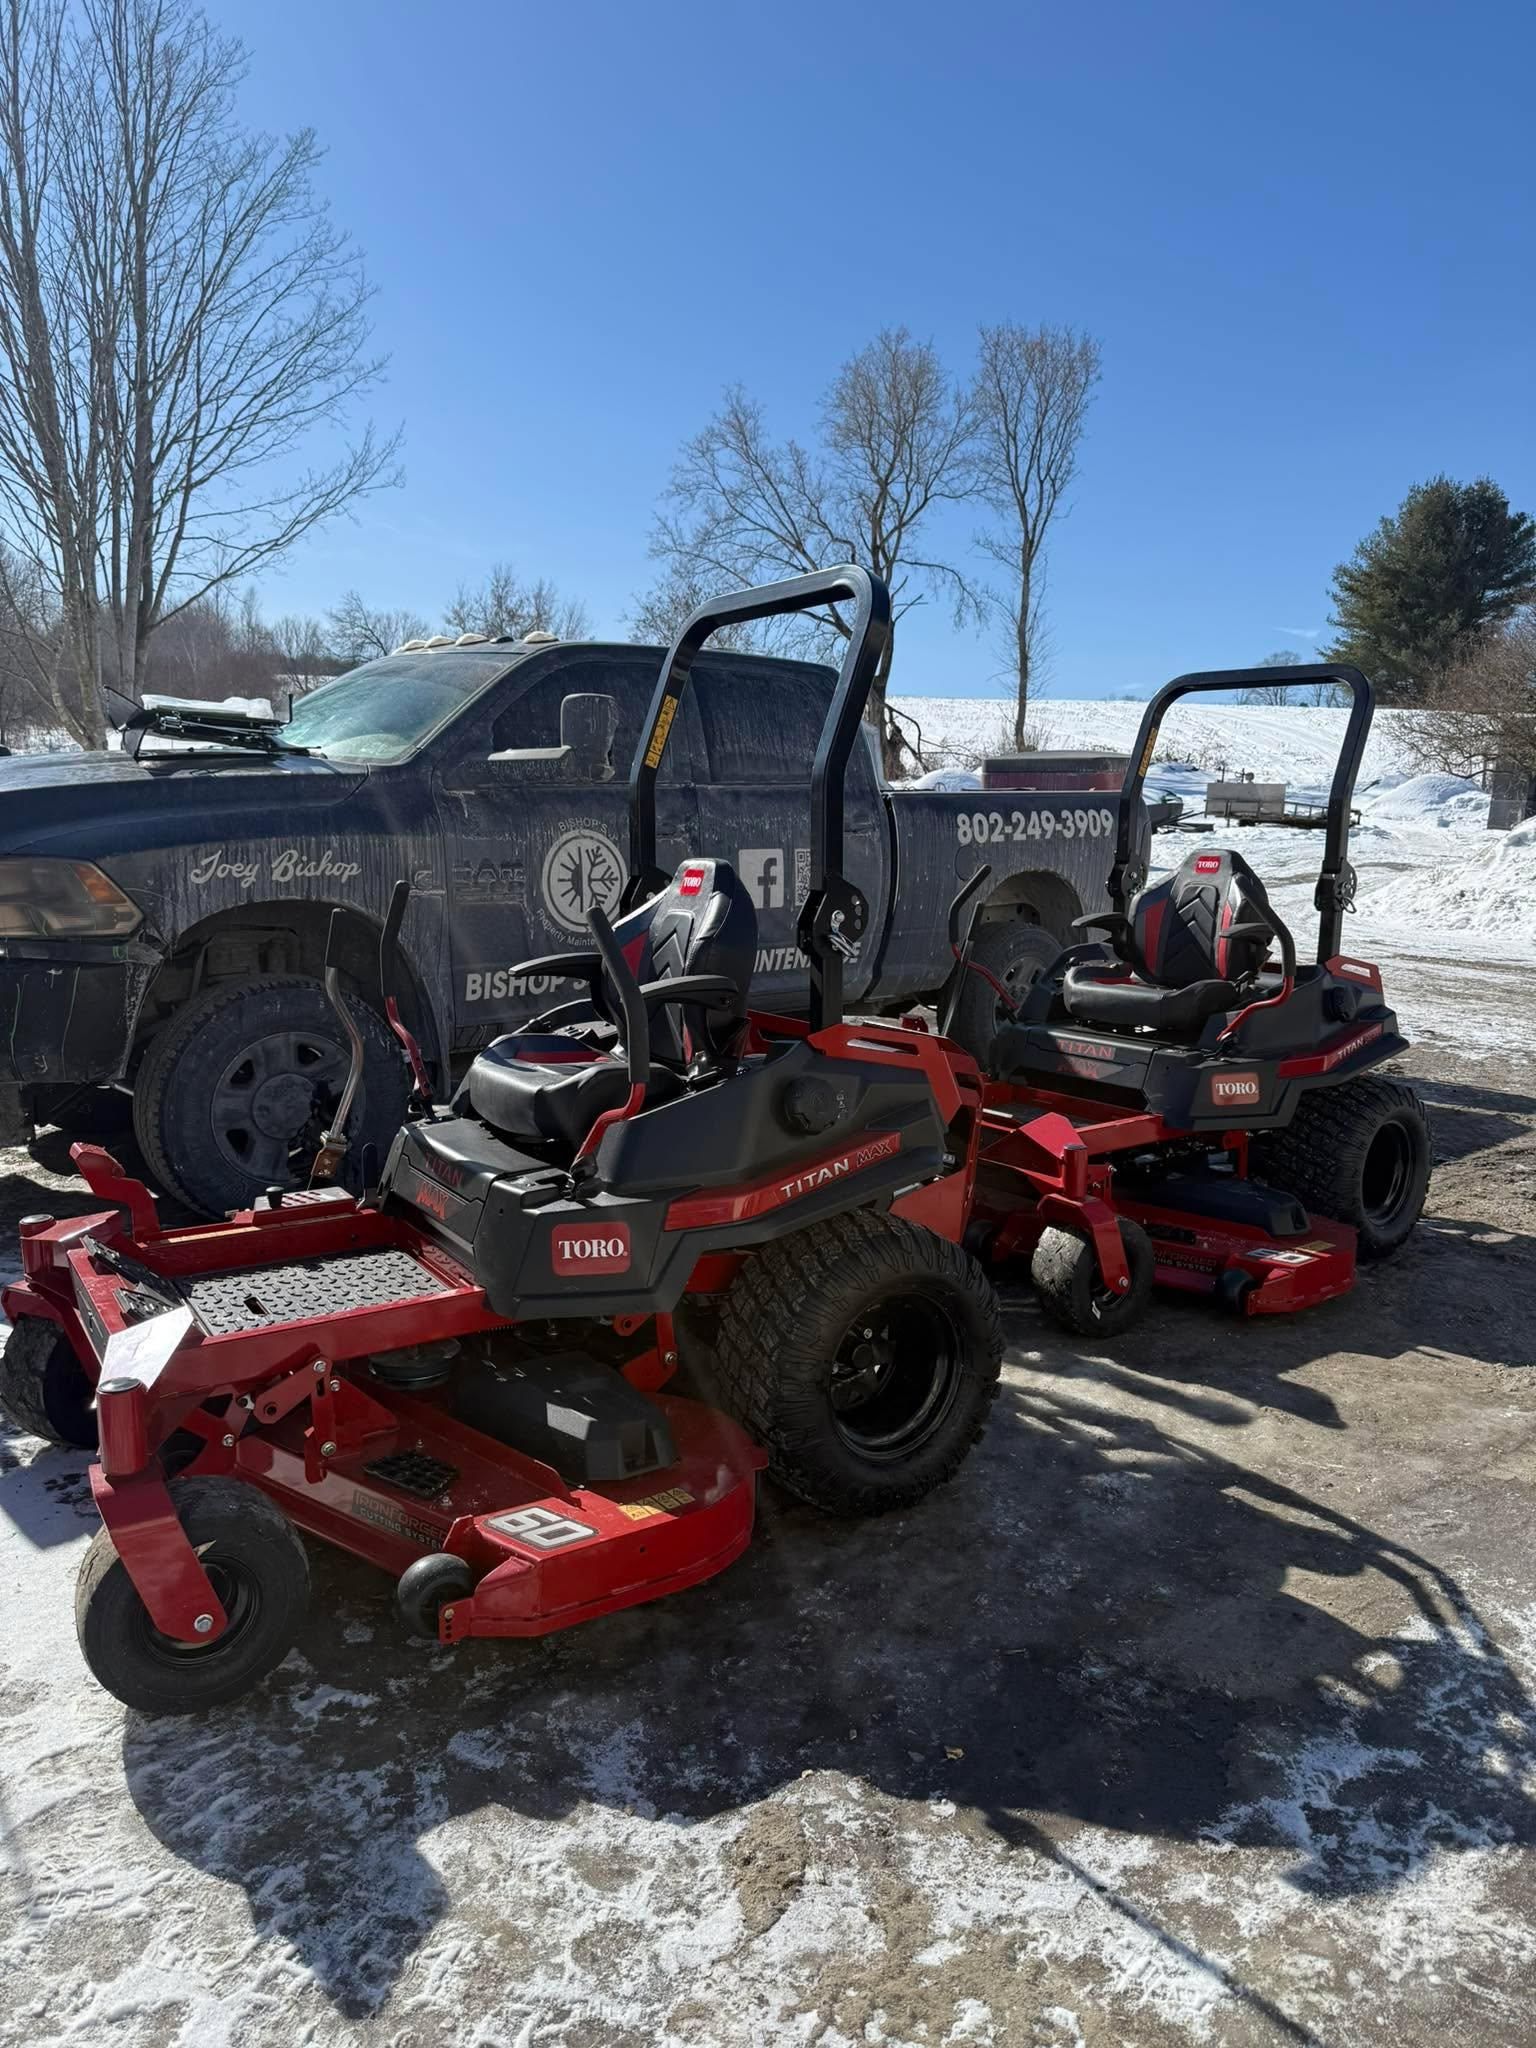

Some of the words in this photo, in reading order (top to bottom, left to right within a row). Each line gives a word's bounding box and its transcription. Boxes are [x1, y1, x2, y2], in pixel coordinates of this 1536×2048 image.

[558, 816, 608, 833] BISHOP'S
[956, 808, 1114, 846] 802-249-3909
[190, 849, 260, 889] Joey
[271, 849, 362, 884] Bishop
[1197, 861, 1219, 869] TORO
[682, 876, 702, 888] TORO
[536, 907, 567, 943] Property
[464, 970, 590, 1001] BISHOP
[1057, 1039, 1112, 1057] TITAN
[1337, 1036, 1365, 1060] TITAN
[1215, 1081, 1257, 1097] TORO
[424, 1151, 464, 1188] TITAN
[780, 1158, 850, 1198] TITAN
[855, 1139, 893, 1168] MAX
[415, 1180, 449, 1221] MAX
[558, 1237, 625, 1260] TORO
[359, 1506, 402, 1533] CUTTING
[486, 1505, 596, 1549] 60
